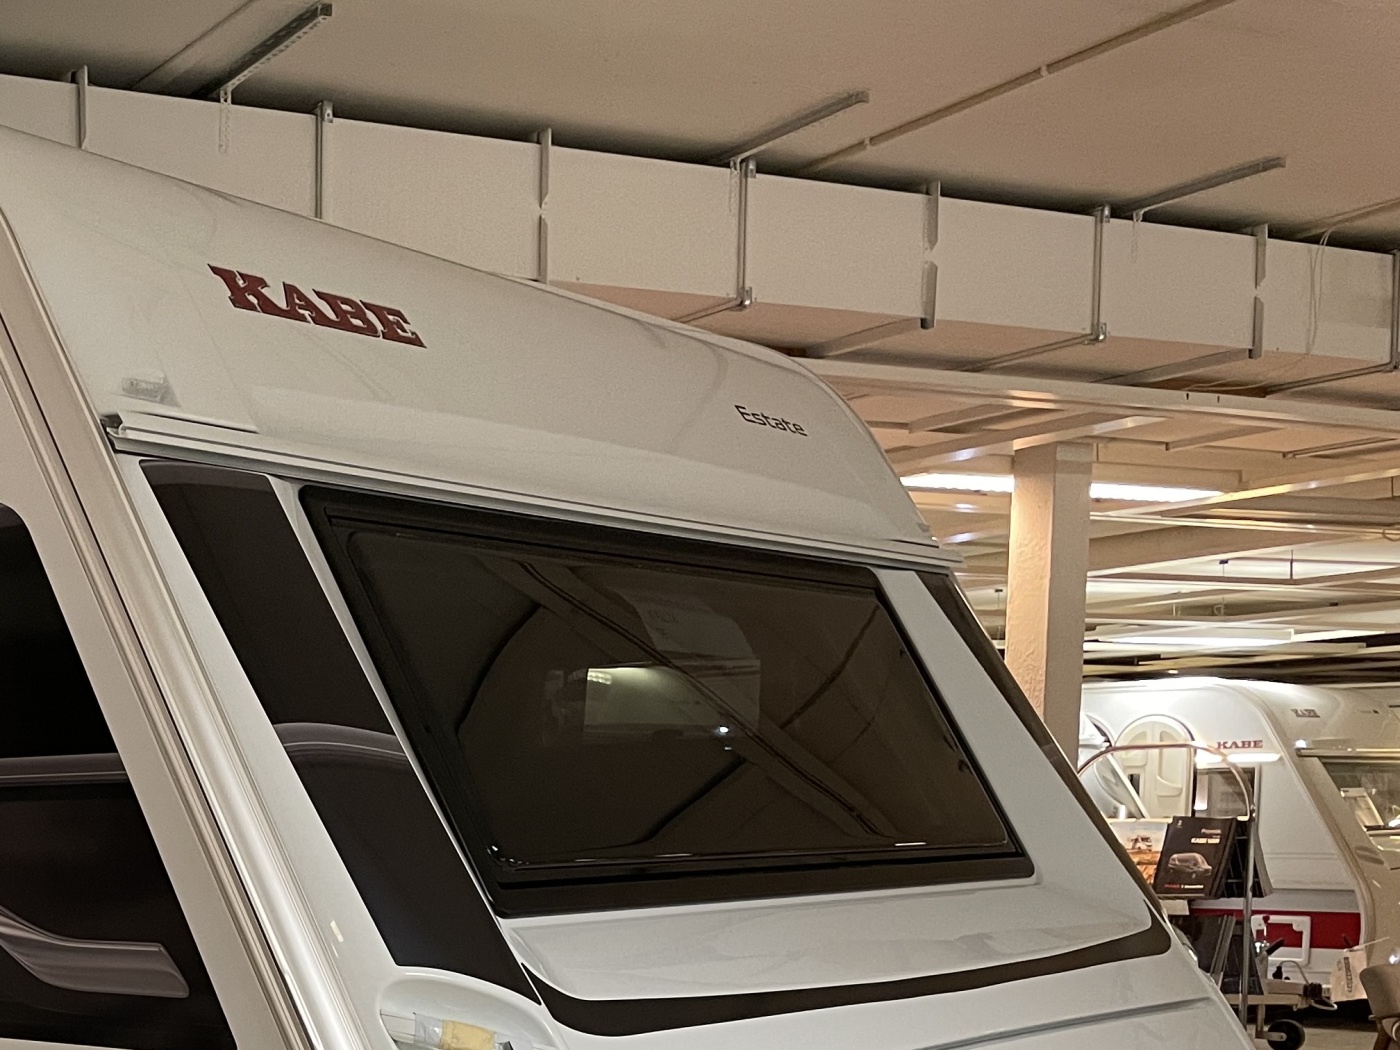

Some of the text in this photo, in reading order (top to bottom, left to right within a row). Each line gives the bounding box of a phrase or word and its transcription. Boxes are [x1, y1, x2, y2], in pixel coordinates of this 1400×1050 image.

[207, 263, 427, 349] KABE
[734, 404, 809, 437] Estate
[1216, 739, 1263, 750] KABE
